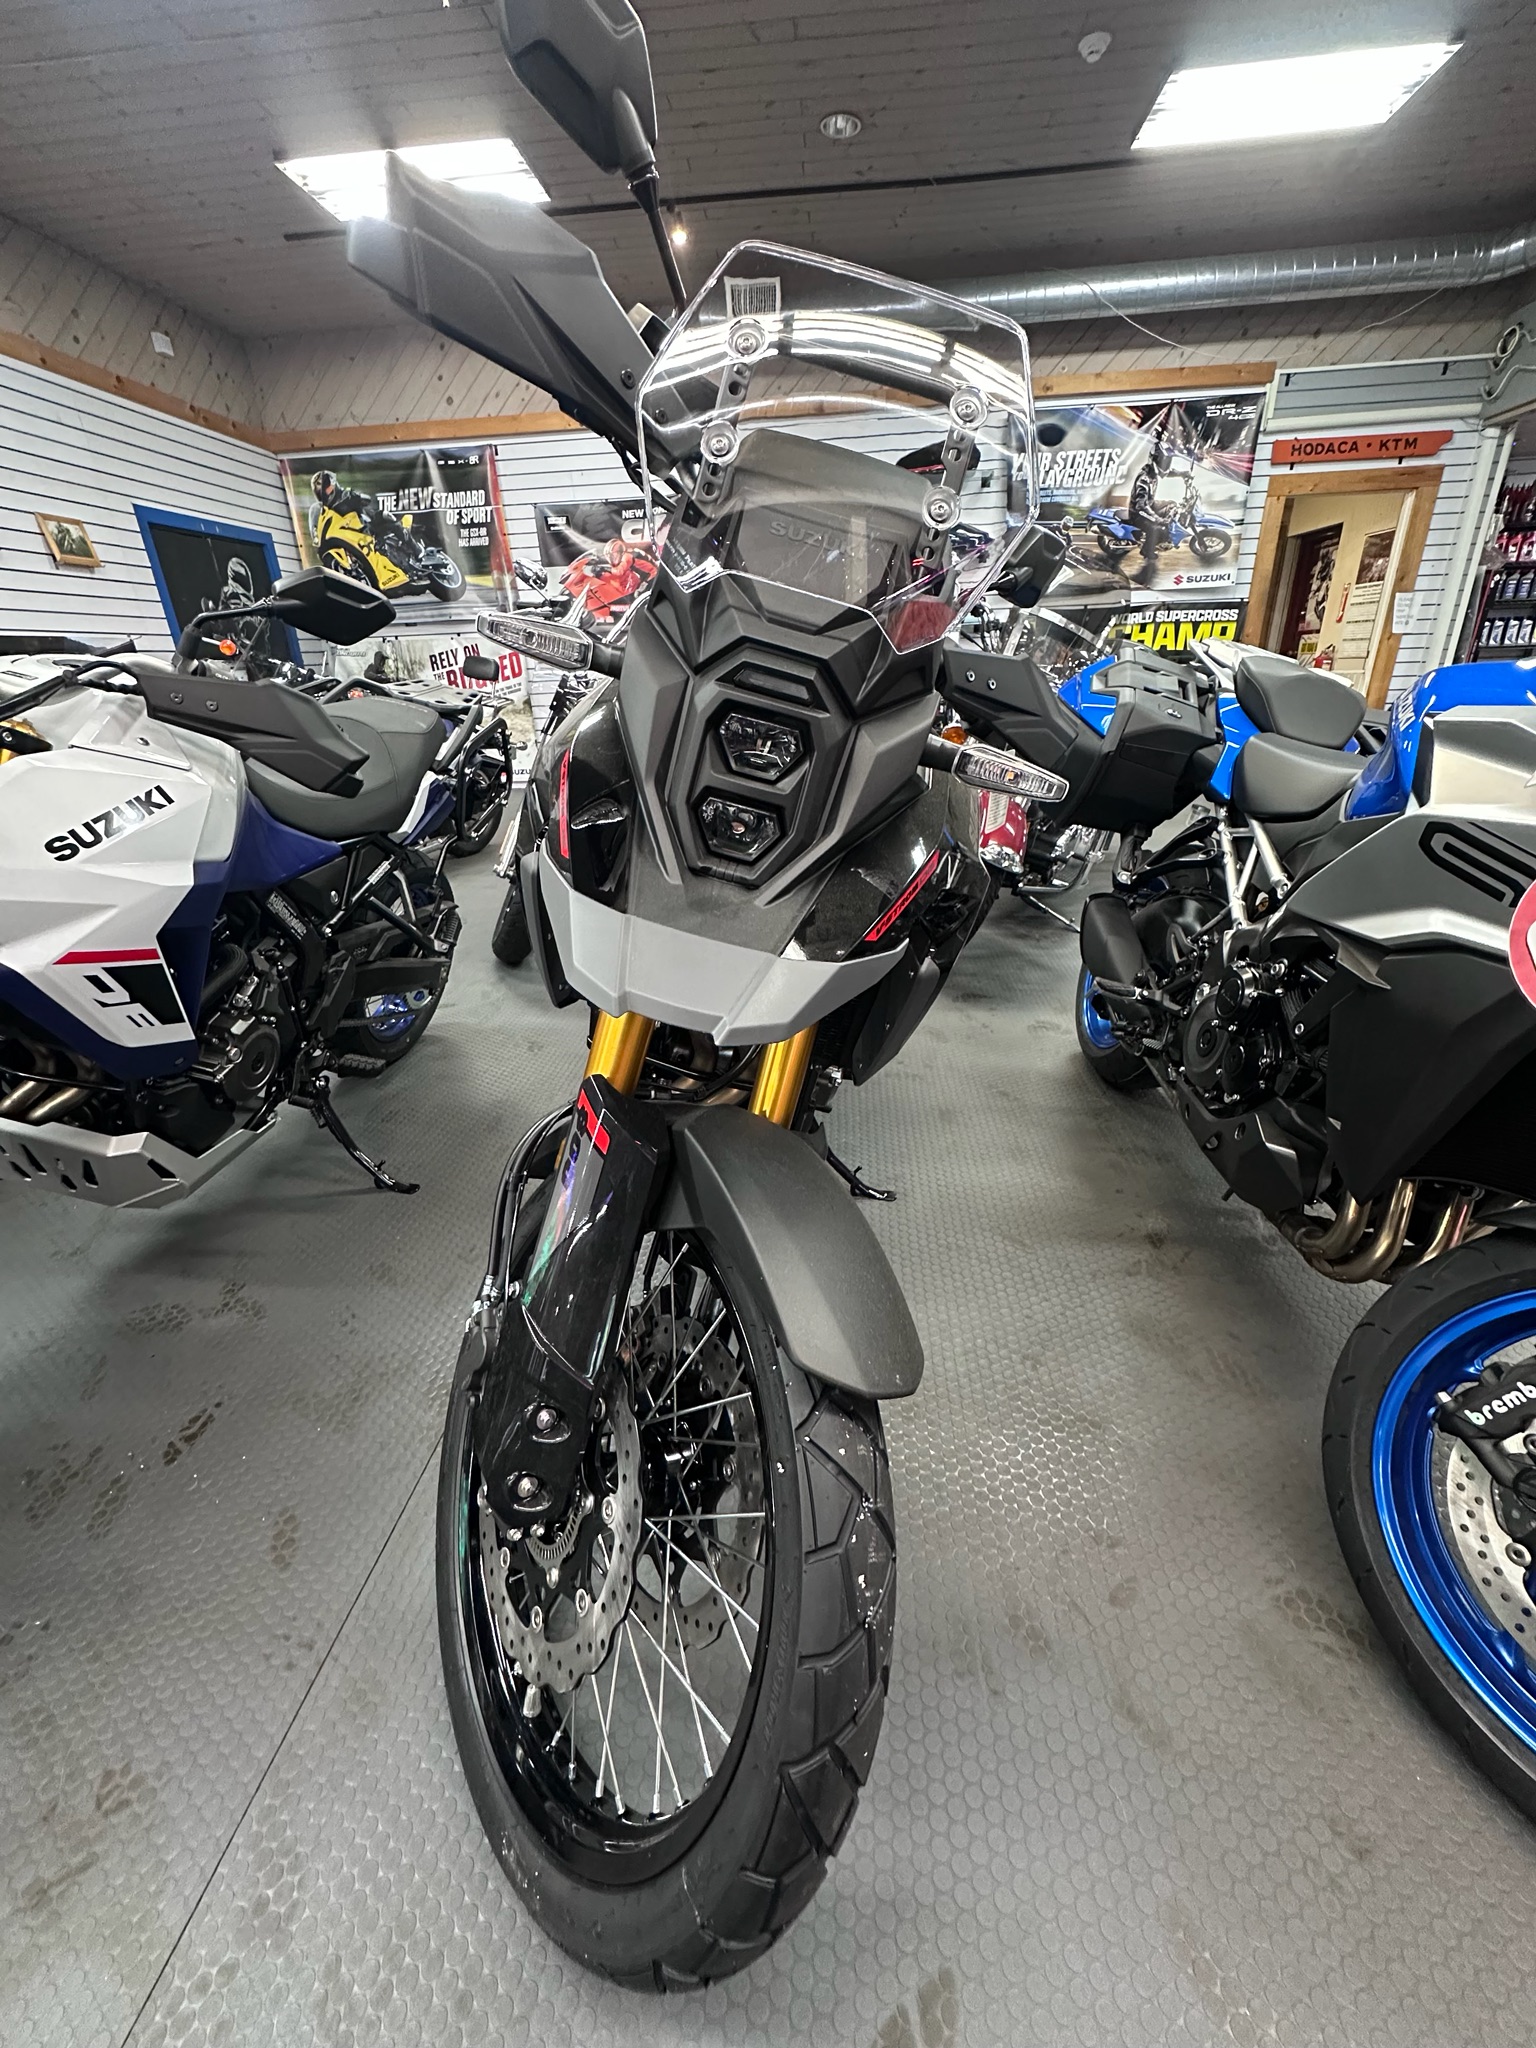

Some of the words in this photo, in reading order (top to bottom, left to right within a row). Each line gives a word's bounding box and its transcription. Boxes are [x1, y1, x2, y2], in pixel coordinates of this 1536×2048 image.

[1290, 441, 1359, 457] HODACA
[1378, 437, 1419, 452] KTM
[1053, 448, 1122, 472] STREETS
[1035, 465, 1129, 488] LAYGROUND
[377, 495, 397, 512] THE
[397, 486, 434, 511] NEW
[432, 489, 486, 508] STANDARD
[446, 508, 460, 525] OF
[460, 506, 493, 524] SPORT
[621, 509, 645, 519] NEW
[1185, 573, 1232, 584] SUZUKI
[1110, 611, 1155, 626] WORLD
[1155, 609, 1240, 623] SUPERCROSS
[429, 648, 459, 672] RELY
[433, 672, 446, 681] THE
[44, 784, 176, 862] SUZUKI
[1463, 1381, 1536, 1426] bremb
